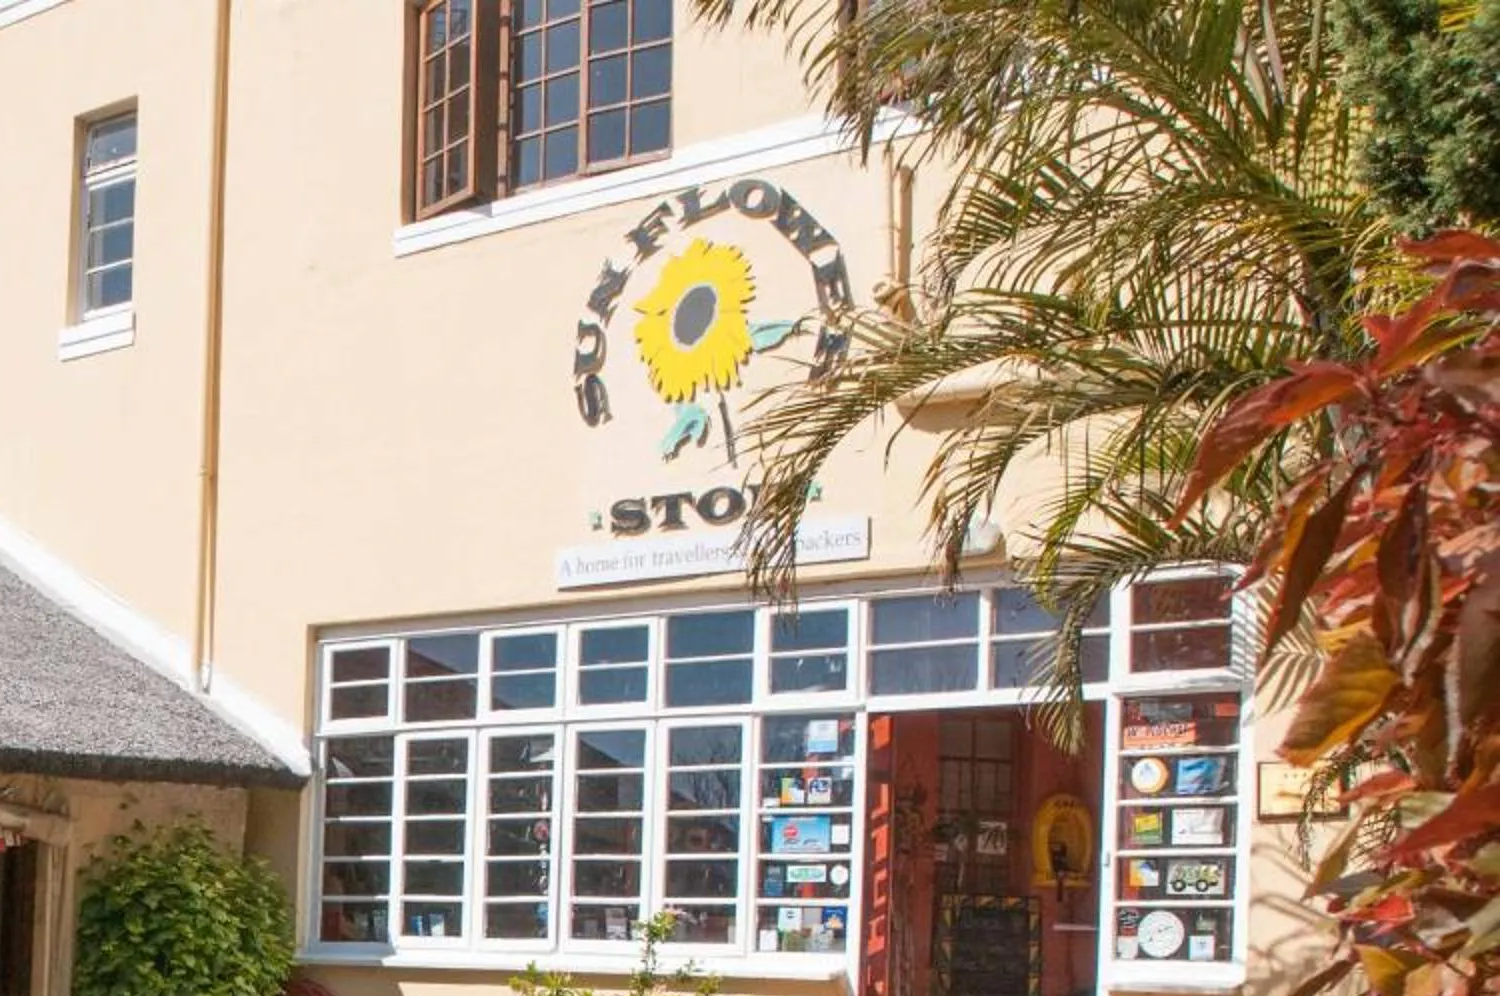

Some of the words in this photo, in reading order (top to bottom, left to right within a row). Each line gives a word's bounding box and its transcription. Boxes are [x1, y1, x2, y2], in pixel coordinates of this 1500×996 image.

[560, 558, 571, 577] A
[576, 555, 619, 575] home
[623, 551, 645, 571] for
